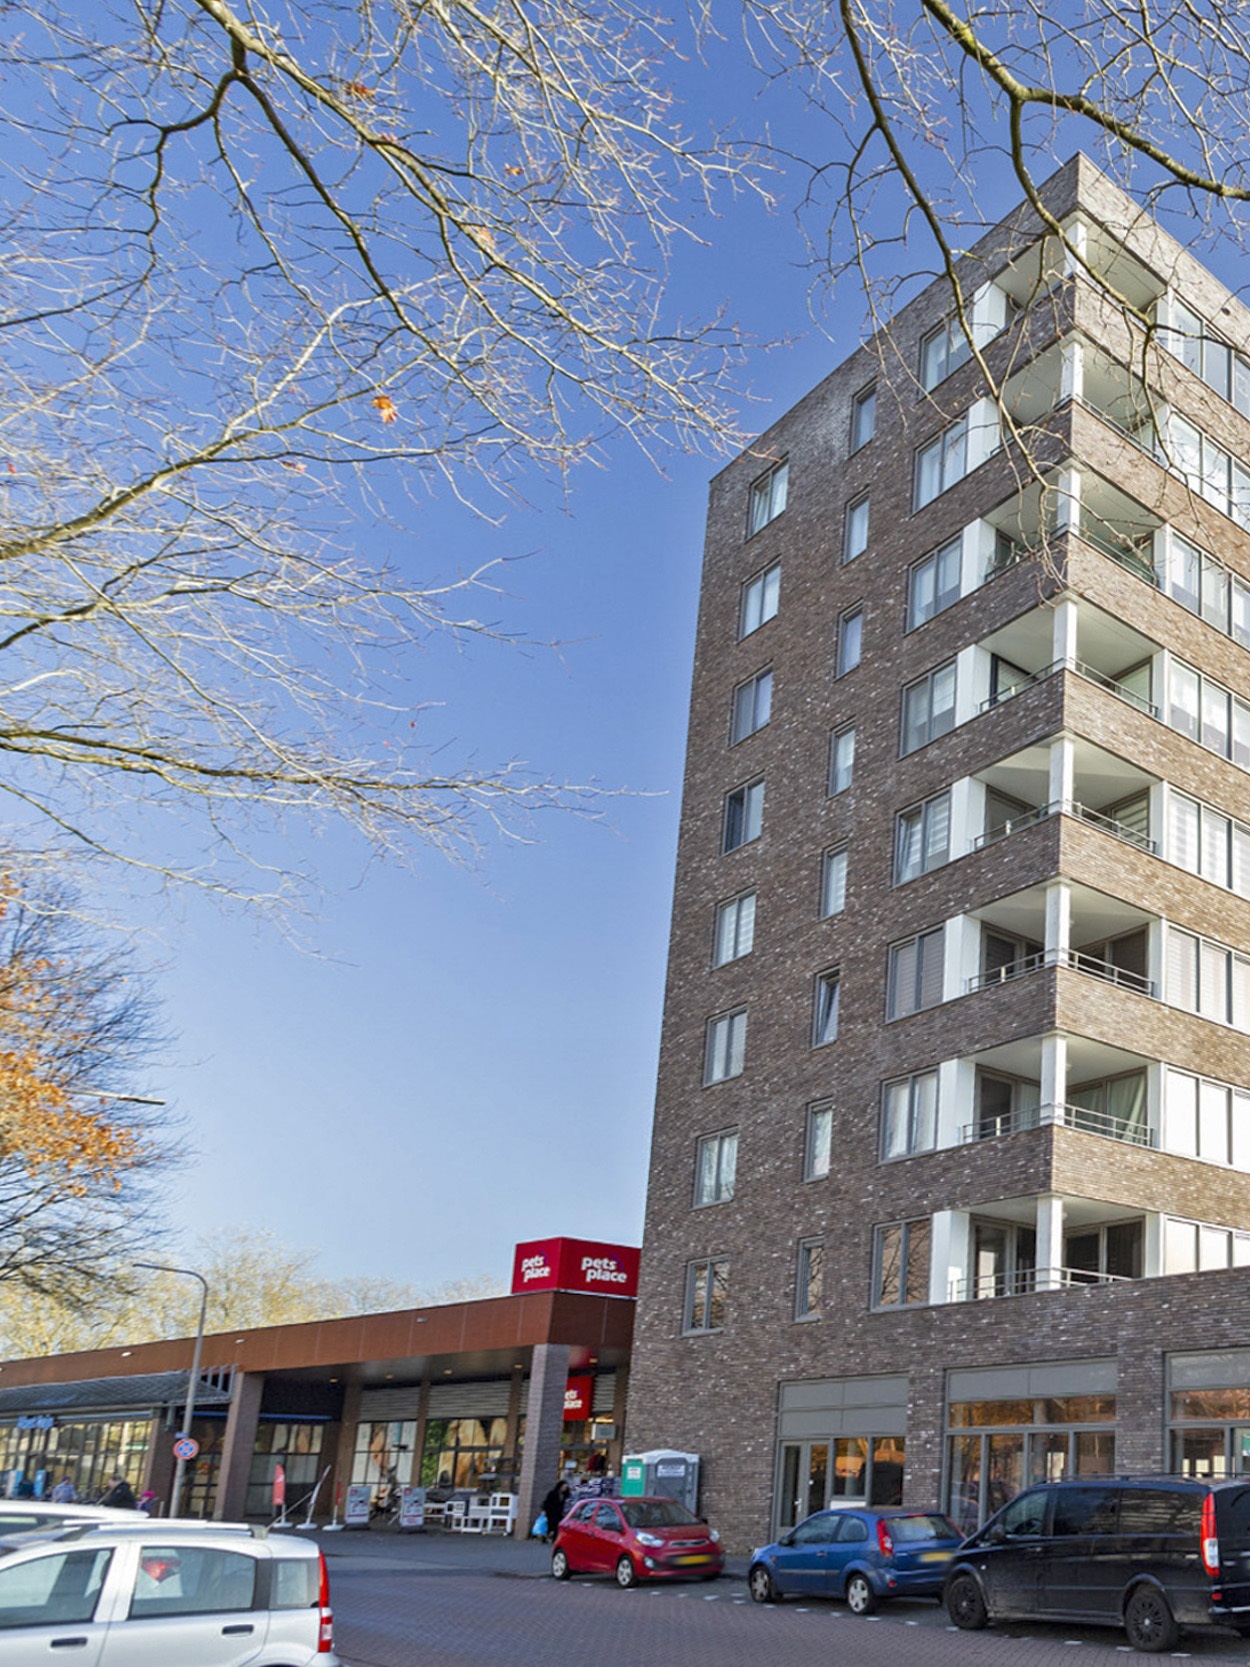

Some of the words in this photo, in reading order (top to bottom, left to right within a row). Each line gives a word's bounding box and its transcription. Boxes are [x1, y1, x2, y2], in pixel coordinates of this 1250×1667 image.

[522, 1256, 544, 1272] pets
[581, 1257, 617, 1270] pets
[524, 1266, 550, 1282] place
[586, 1269, 627, 1282] place
